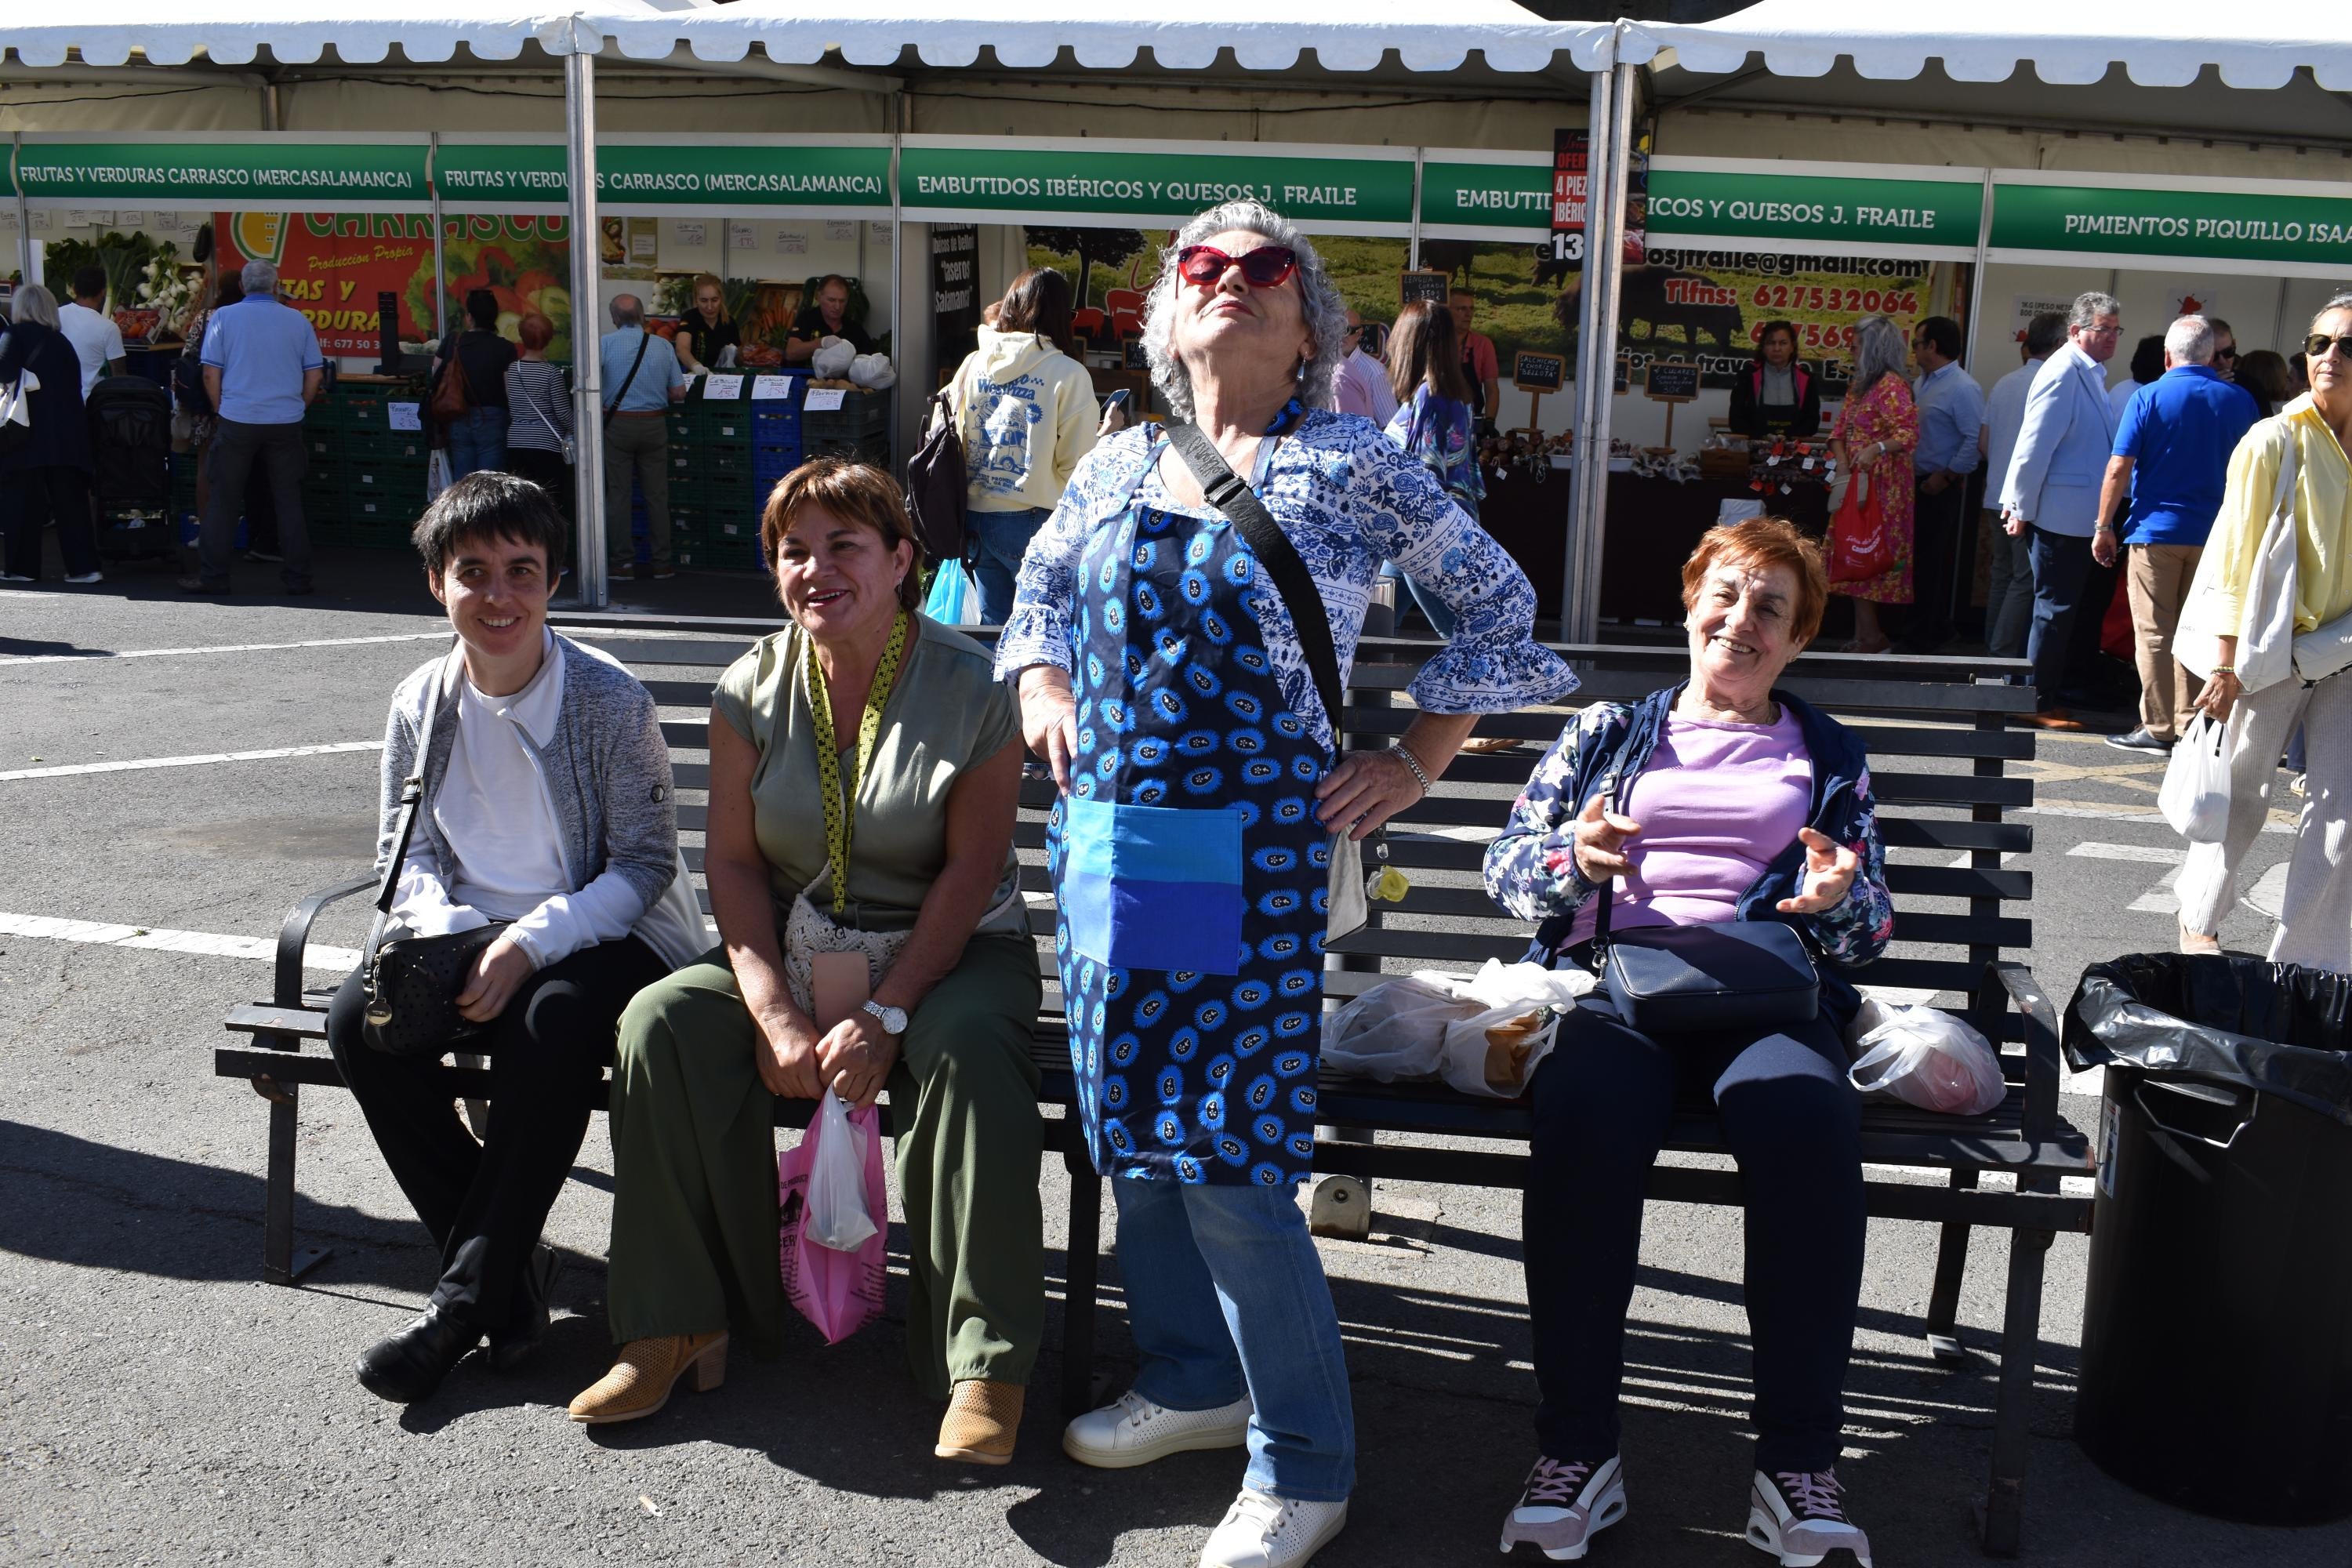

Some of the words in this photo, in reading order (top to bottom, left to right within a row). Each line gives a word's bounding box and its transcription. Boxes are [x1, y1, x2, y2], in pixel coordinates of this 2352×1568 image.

[20, 167, 74, 183] FRUTAS
[76, 168, 86, 183] Y
[88, 168, 166, 184] VERDURAS
[169, 169, 250, 186] CARRASCO
[253, 170, 412, 189] (MERCASALAMANCA)
[445, 171, 505, 187] FRUTAS
[506, 172, 517, 187] Y
[519, 172, 605, 189] VERDUS
[611, 173, 701, 191] CARRASCO
[706, 174, 883, 194] (MERCASALAMANCA)
[1555, 176, 1564, 196] 4
[918, 176, 1041, 197] EMBUTIDOS
[1047, 174, 1144, 199] IBÉRICOS
[1149, 183, 1163, 200] Y
[1167, 182, 1254, 202] QUESOS
[1283, 186, 1358, 206] FRAILE
[1709, 200, 1726, 220] Y
[1729, 201, 1825, 224] QUESOS
[1831, 206, 1850, 226] J.
[1857, 207, 1936, 230] FRAILE
[2065, 214, 2190, 238] PIMIENTOS
[2196, 219, 2303, 242] PIQUILLO
[373, 244, 416, 263] Propia
[339, 280, 356, 302] Y
[1664, 278, 1737, 307] Tlfns:
[1753, 284, 1918, 314] 627532064
[334, 339, 353, 349] 677
[357, 340, 371, 350] 50
